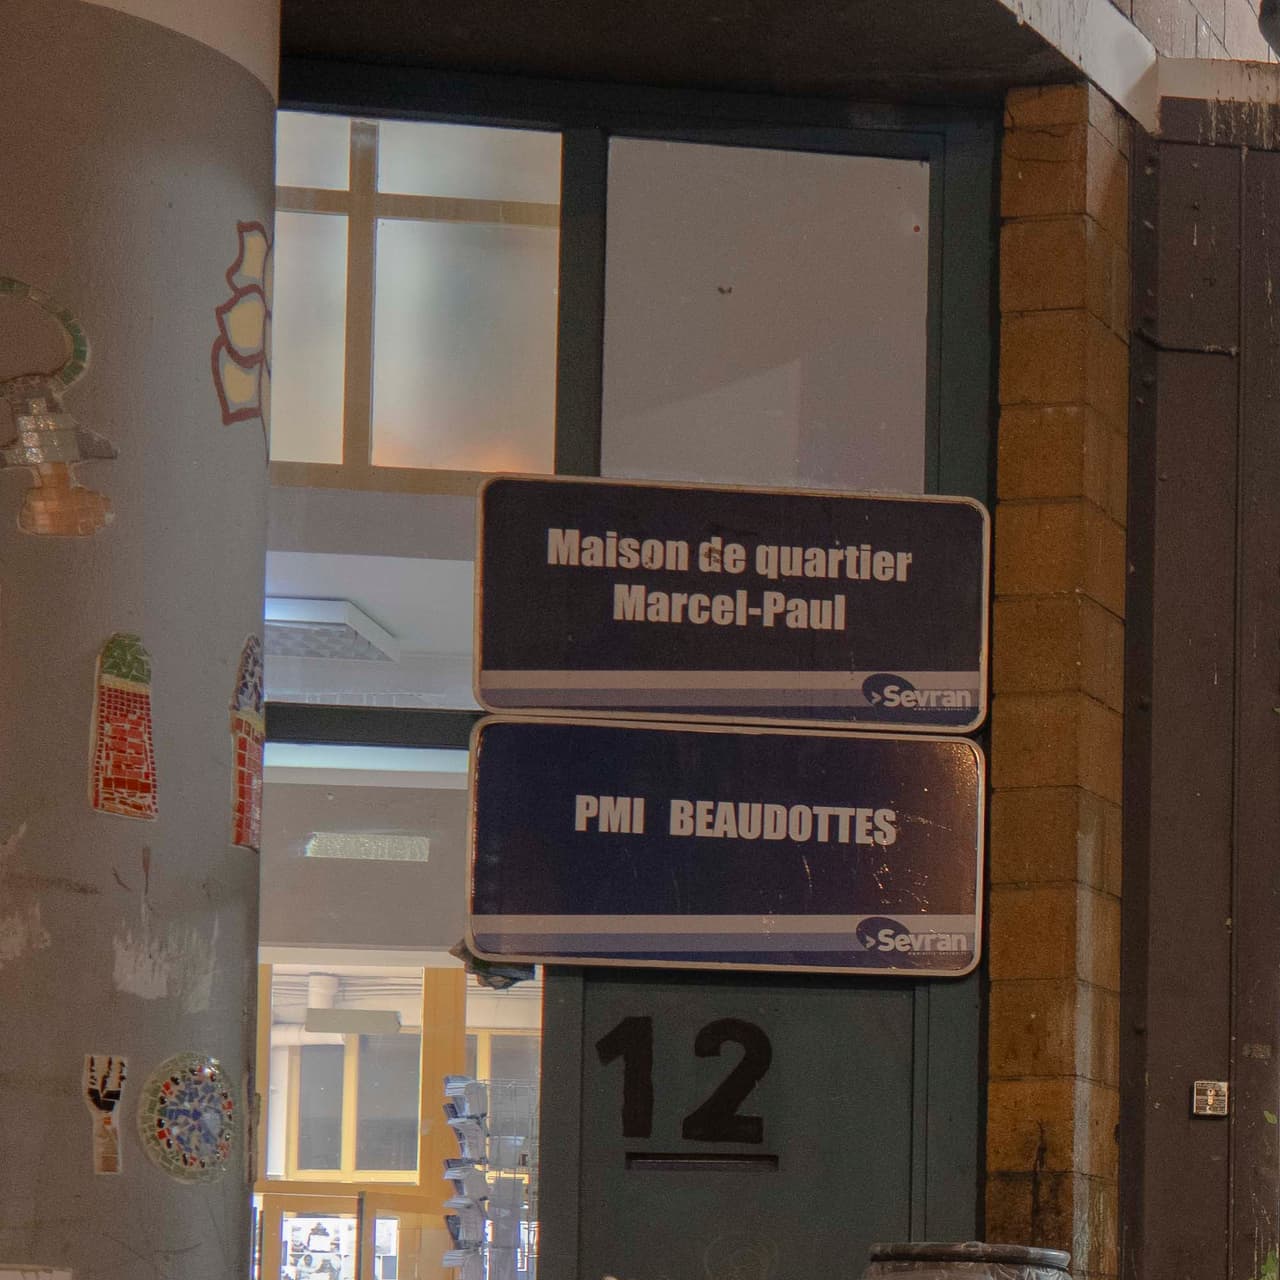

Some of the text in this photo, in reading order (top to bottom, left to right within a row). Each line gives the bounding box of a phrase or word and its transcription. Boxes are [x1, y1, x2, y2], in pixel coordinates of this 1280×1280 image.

[547, 528, 912, 582] Maison de quartier
[613, 583, 846, 630] Marcel-Paul
[883, 685, 971, 708] Sevran
[575, 795, 897, 846] PMI BEAUDOTTES
[878, 929, 967, 952] Sevran
[595, 1015, 773, 1144] 12
